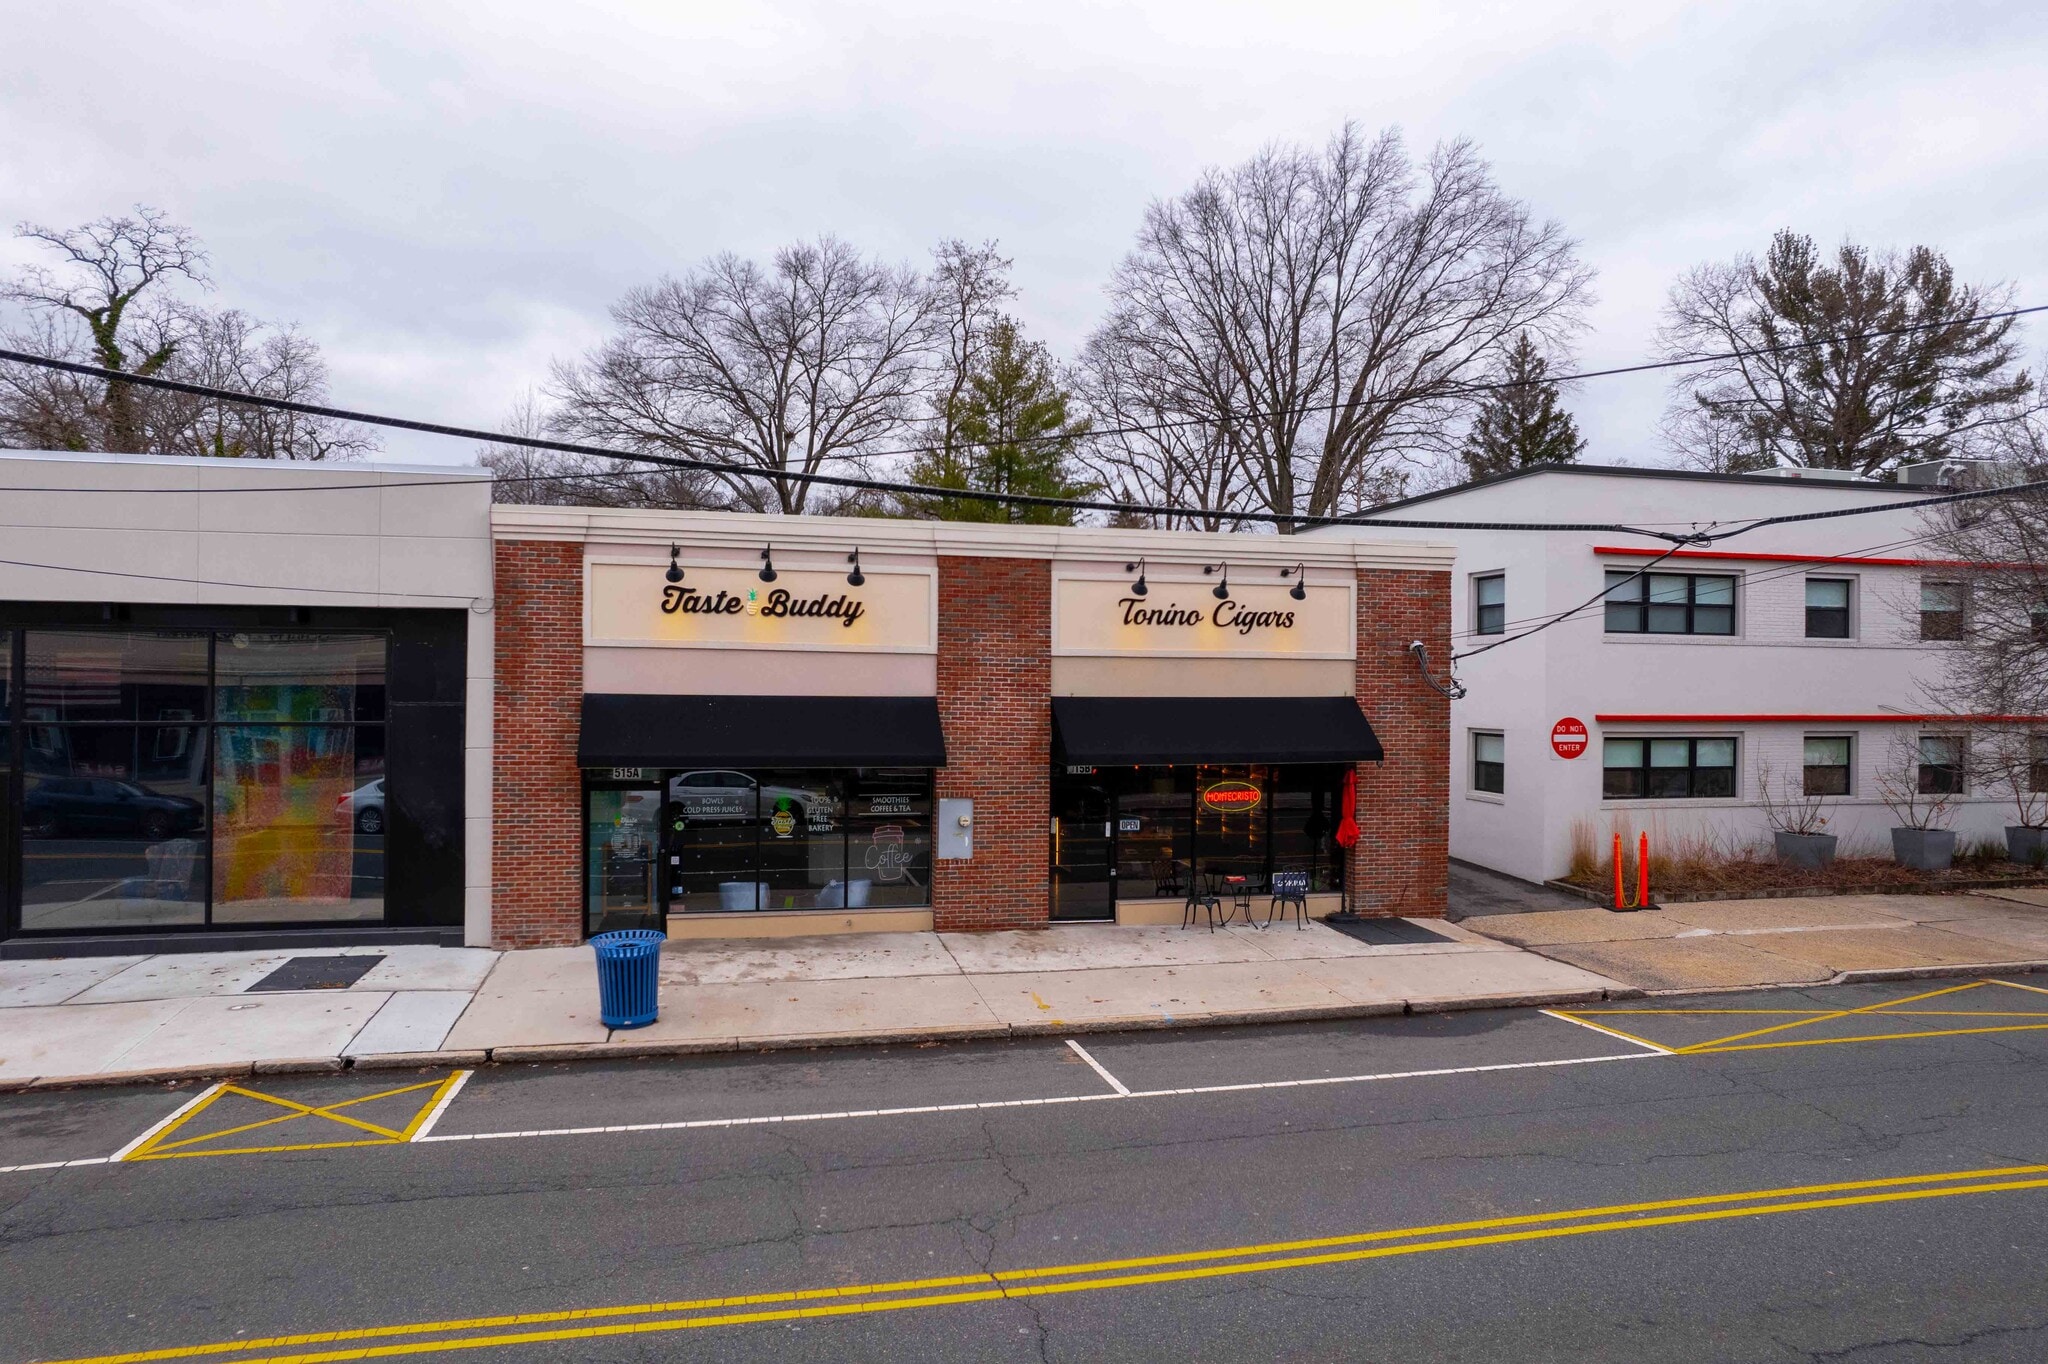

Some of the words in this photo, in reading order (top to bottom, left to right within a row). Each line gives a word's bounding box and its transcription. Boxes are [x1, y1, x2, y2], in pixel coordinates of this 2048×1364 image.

[661, 585, 744, 614] Taste
[760, 589, 865, 628] Buddy
[1118, 598, 1204, 625] Tonino
[1212, 600, 1295, 635] Cigars
[1556, 725, 1566, 733] DO
[1570, 725, 1583, 733] NOT
[614, 768, 640, 778] 515A
[701, 797, 724, 805] BOWLS
[810, 796, 832, 804] 100%
[872, 796, 910, 804] SMOOTHIES
[1206, 791, 1259, 802] MONTECRISTO
[683, 806, 701, 814] COLD
[721, 805, 743, 813] JUICES
[806, 806, 833, 814] GLUTEN
[870, 805, 892, 813] COFFEE
[899, 804, 911, 812] TEA
[812, 815, 828, 823] FREE
[808, 824, 834, 832] BAKERY
[1121, 821, 1139, 830] OPEN
[865, 843, 913, 870] Coffee
